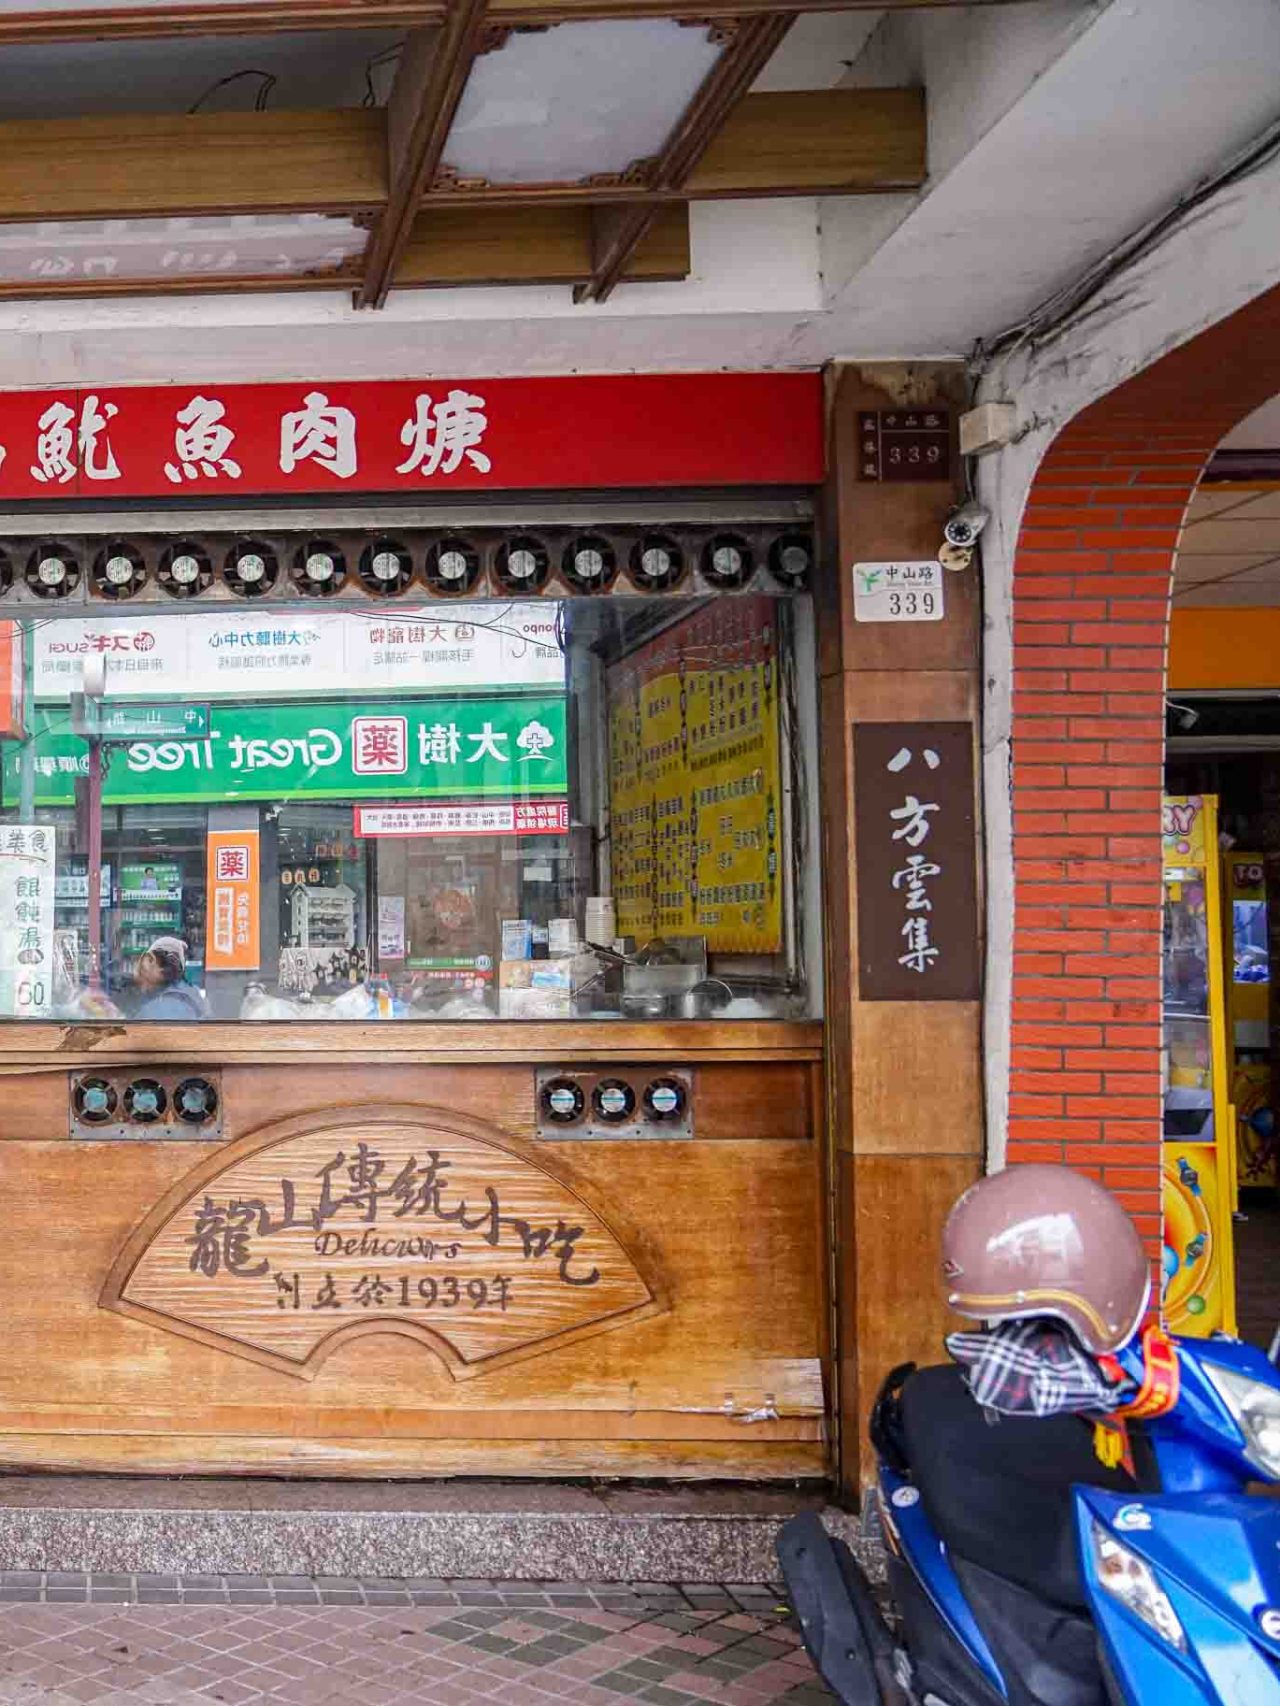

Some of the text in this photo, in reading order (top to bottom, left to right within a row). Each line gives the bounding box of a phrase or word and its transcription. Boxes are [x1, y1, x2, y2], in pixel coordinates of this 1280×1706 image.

[889, 445, 940, 464] 339
[886, 565, 934, 580] 中山路
[889, 592, 935, 615] 339
[886, 747, 941, 973] 八方雲集
[184, 1143, 599, 1285] 龍山傳統小吃
